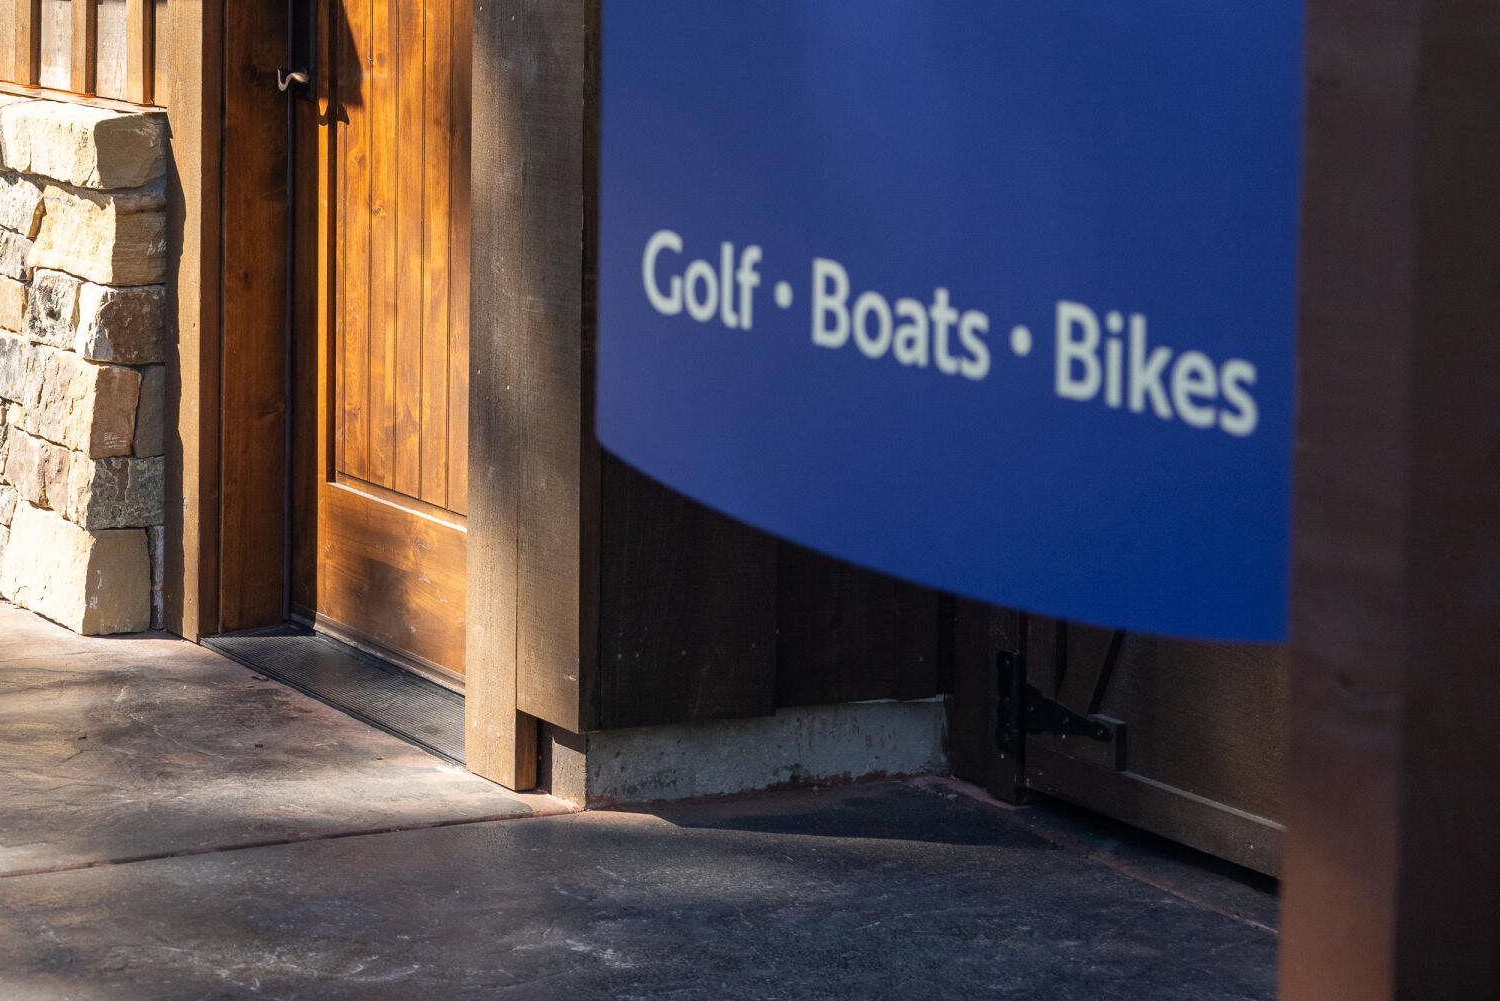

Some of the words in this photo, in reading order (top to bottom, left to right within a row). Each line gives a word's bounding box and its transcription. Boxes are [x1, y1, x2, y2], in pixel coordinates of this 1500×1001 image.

[642, 230, 763, 331] Golf
[811, 258, 991, 380] Boats
[1056, 301, 1259, 437] Bikes
